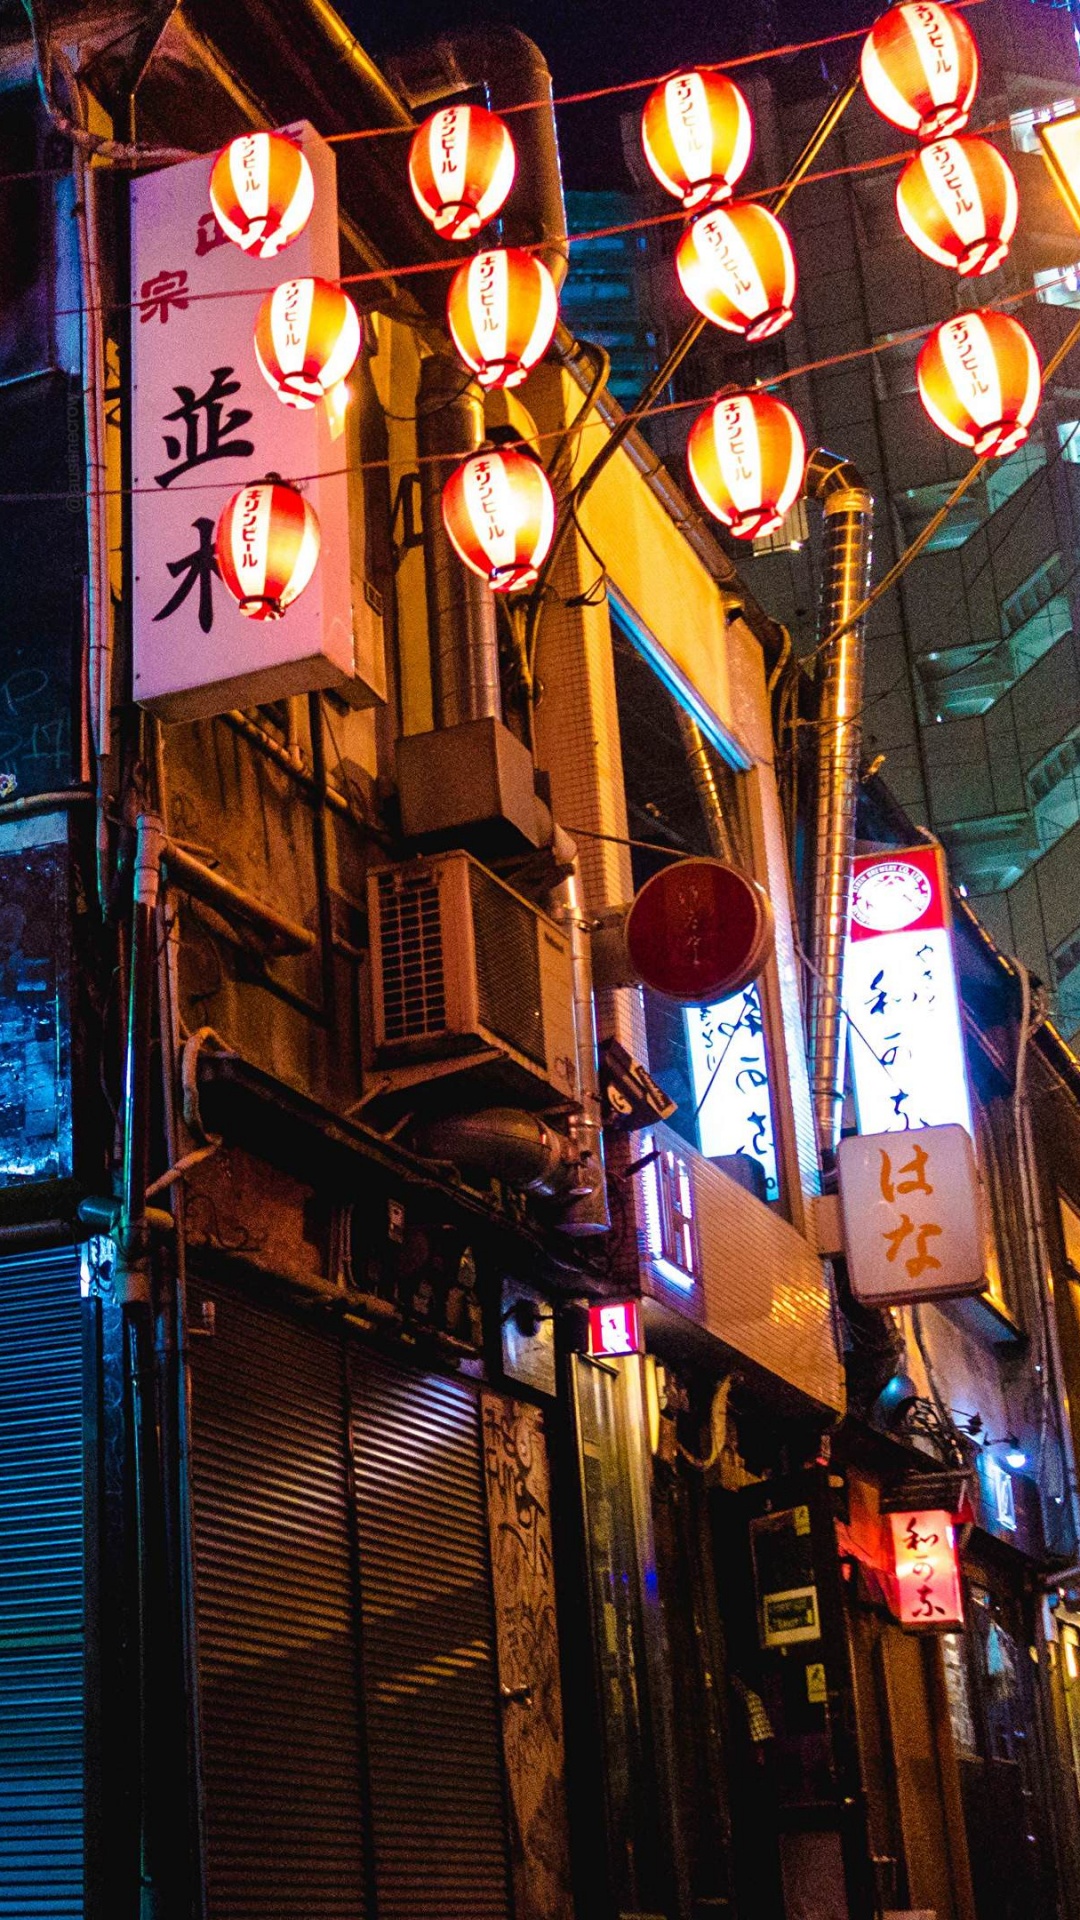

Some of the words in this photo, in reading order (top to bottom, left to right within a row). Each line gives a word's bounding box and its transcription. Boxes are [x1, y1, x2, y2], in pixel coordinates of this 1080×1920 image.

[914, 5, 952, 74] キリンビール
[932, 145, 973, 216] キリンビール
[480, 255, 499, 332] キリンビール
[950, 320, 989, 397] キリンビール
[242, 489, 263, 568] キリンビール
[474, 460, 505, 541] キリンビール
[880, 1143, 943, 1278] はな
